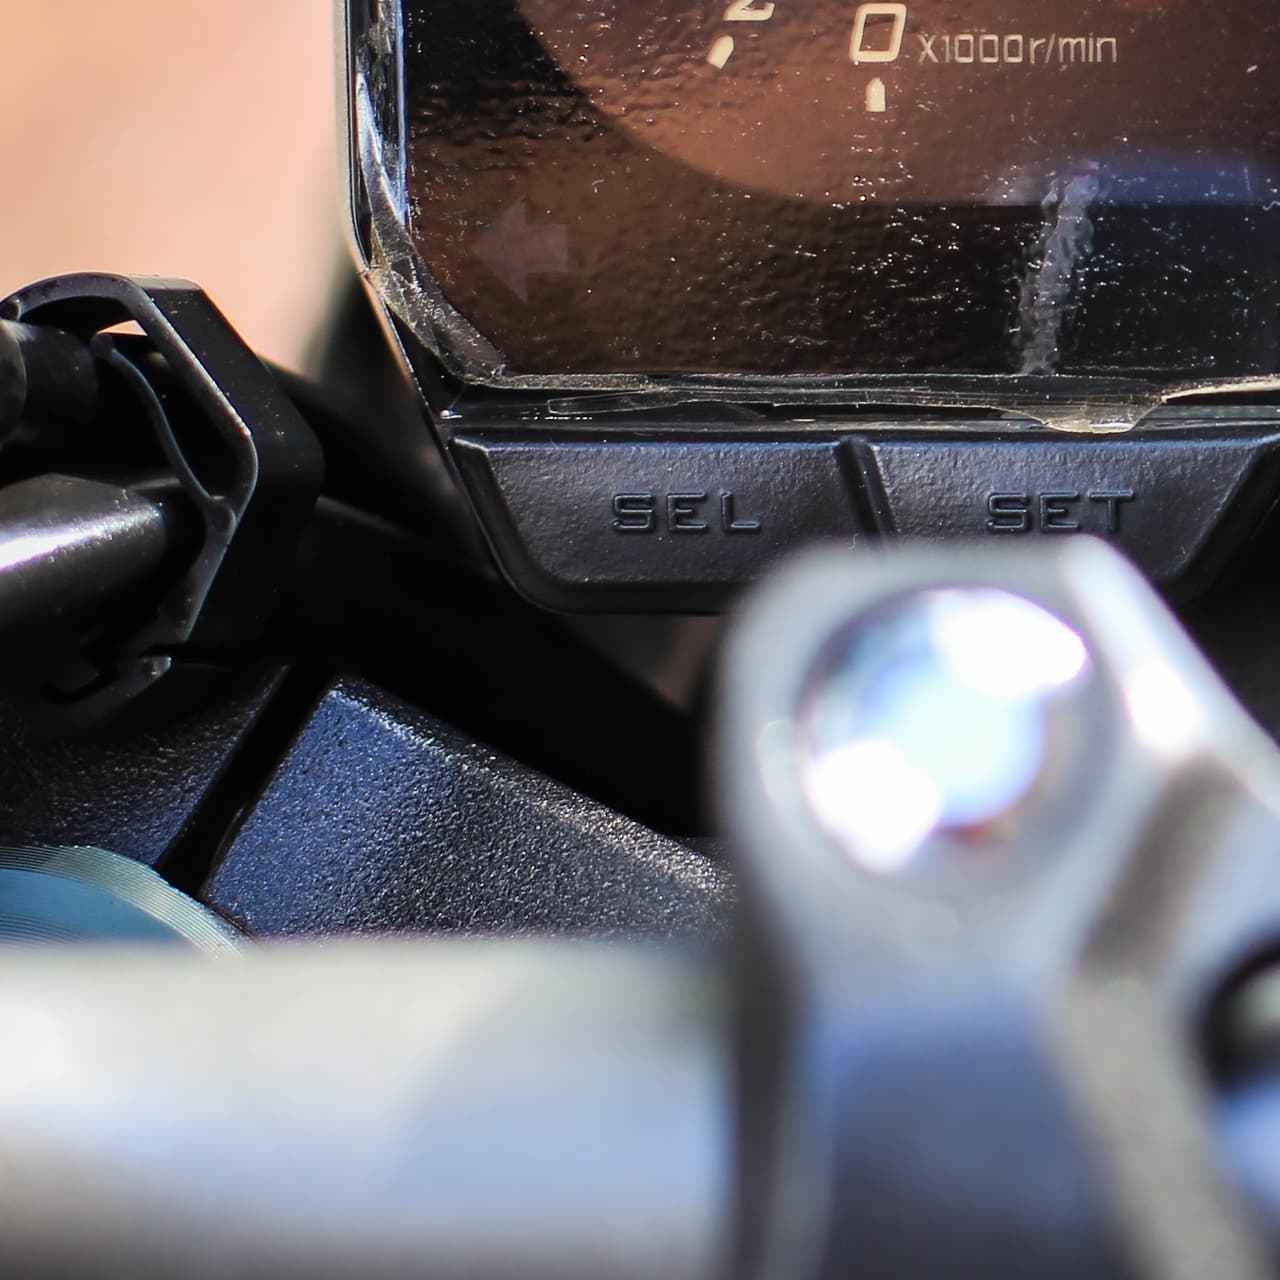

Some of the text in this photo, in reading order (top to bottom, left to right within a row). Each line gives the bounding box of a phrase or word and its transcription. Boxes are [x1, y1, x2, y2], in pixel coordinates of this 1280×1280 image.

[850, 3, 907, 64] 0
[611, 491, 761, 535] SEL
[987, 489, 1137, 534] SET
